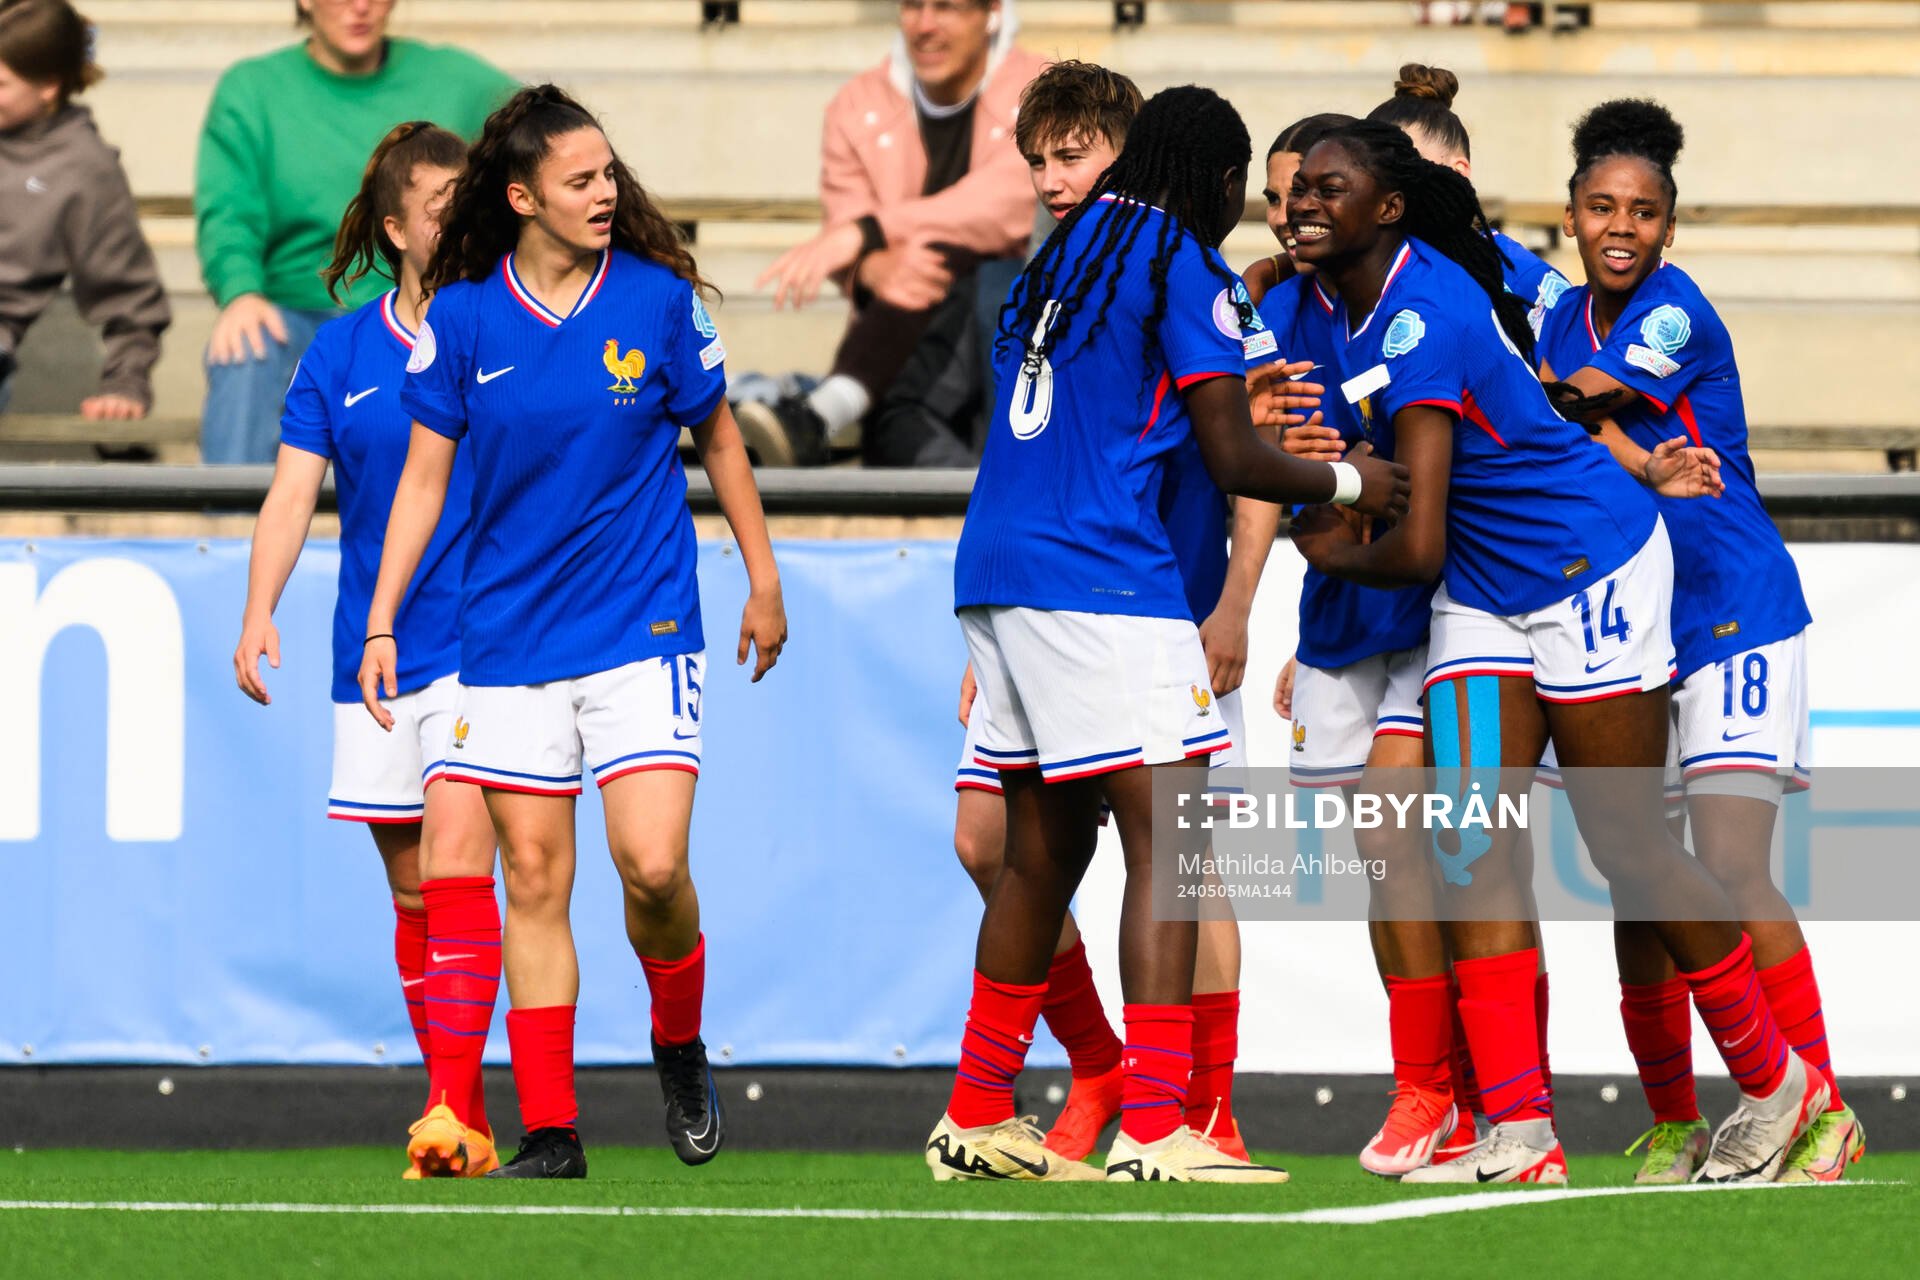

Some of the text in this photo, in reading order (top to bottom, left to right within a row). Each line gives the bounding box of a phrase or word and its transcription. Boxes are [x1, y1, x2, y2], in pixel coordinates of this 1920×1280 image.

[1570, 578, 1633, 654] 14
[660, 655, 702, 725] 15
[1714, 651, 1770, 720] 18
